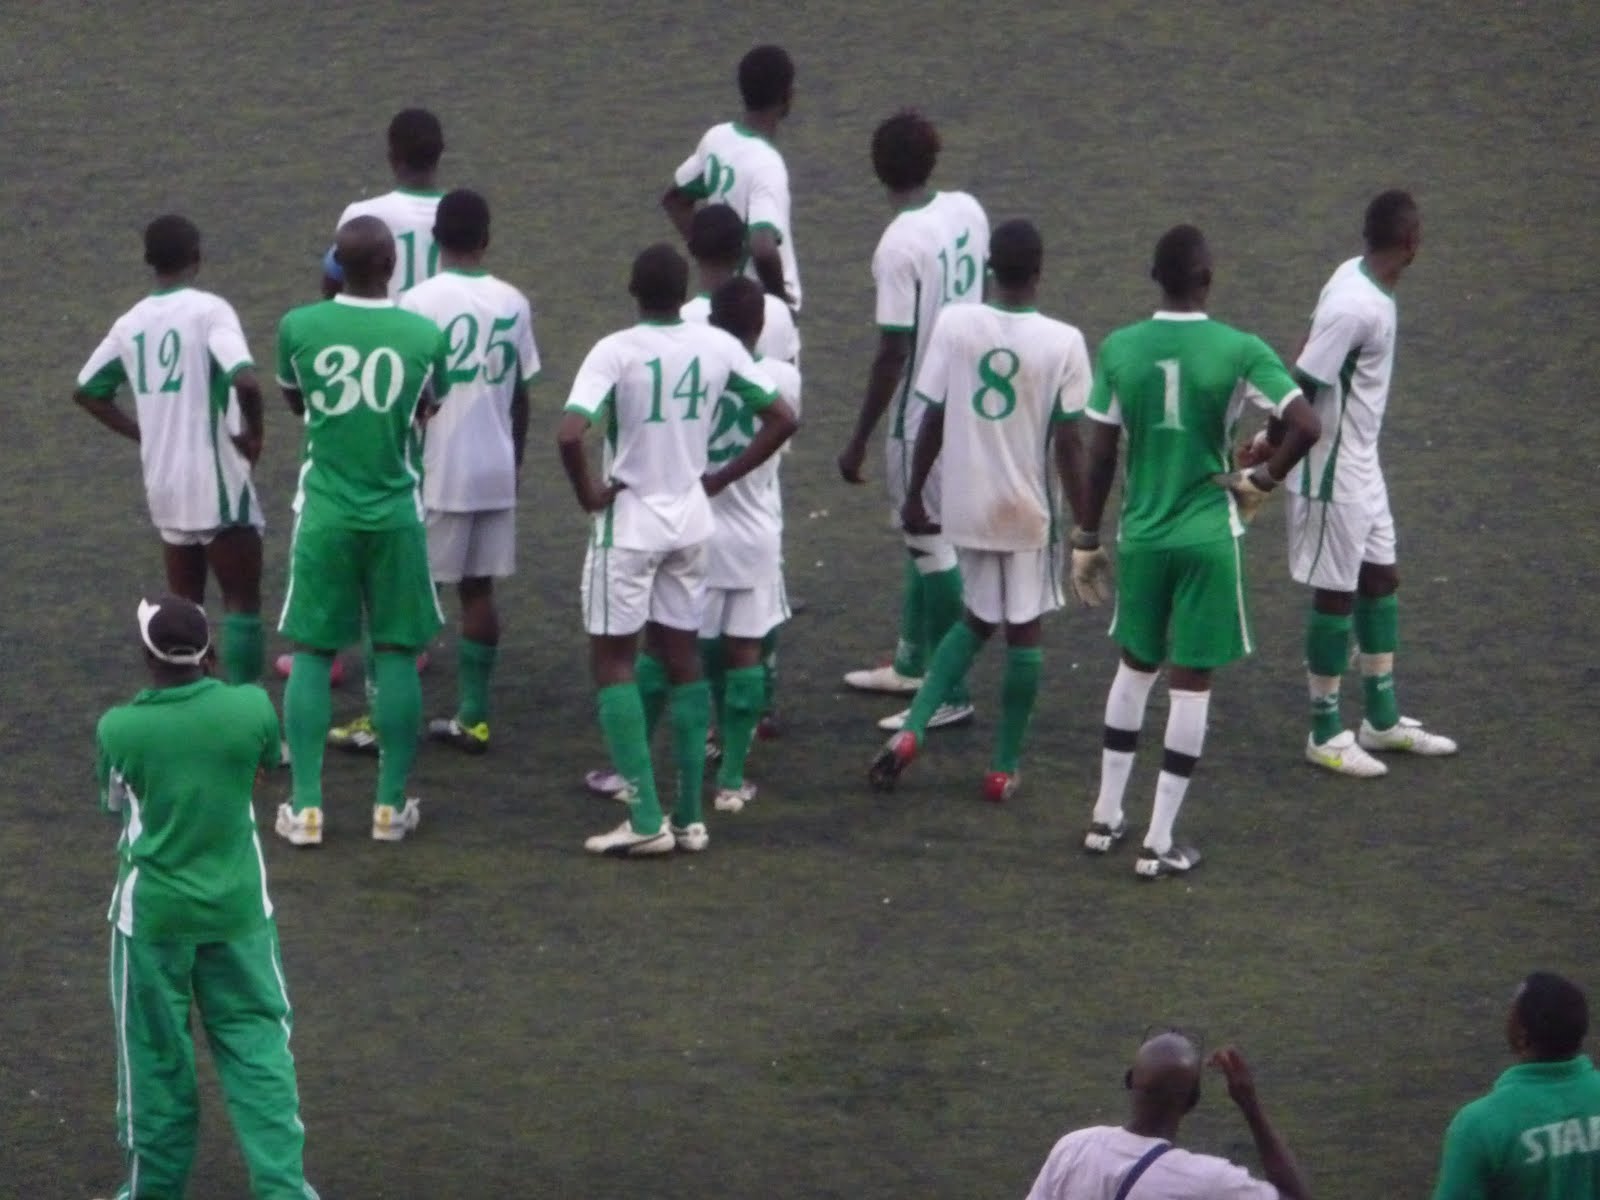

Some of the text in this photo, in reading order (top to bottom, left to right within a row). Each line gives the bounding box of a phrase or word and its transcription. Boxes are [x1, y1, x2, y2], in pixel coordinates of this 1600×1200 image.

[937, 228, 977, 303] 15
[132, 328, 185, 395] 12
[309, 344, 405, 416] 30
[442, 312, 520, 385] 25
[971, 347, 1021, 421] 8
[643, 355, 709, 423] 14
[1152, 358, 1186, 432] 1
